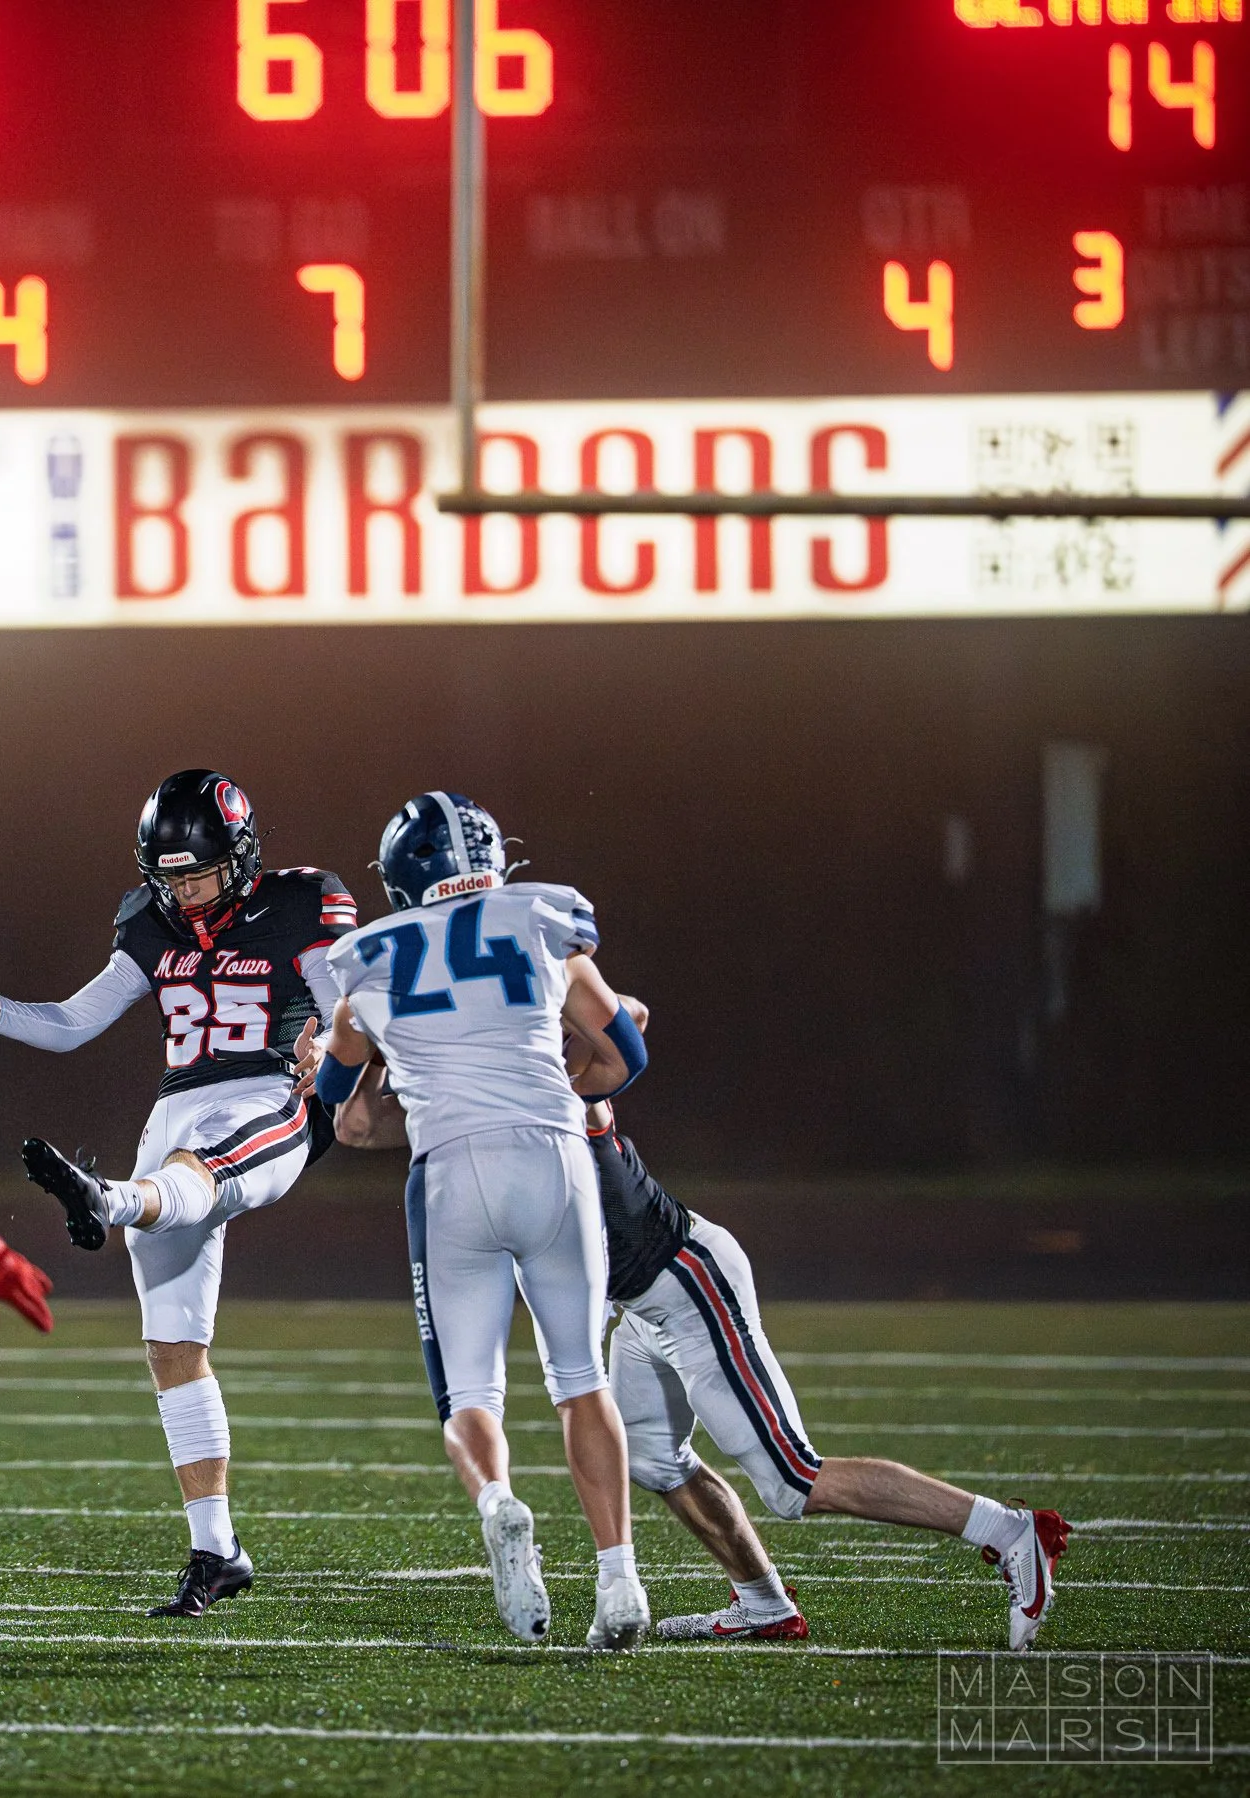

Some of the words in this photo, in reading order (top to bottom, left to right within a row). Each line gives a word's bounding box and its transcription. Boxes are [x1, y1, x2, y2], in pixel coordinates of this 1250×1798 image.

[1108, 40, 1216, 151] 14
[297, 264, 365, 381] 7
[883, 260, 954, 371] 4
[1073, 231, 1125, 330] 3
[161, 855, 190, 865] Riddell
[437, 874, 493, 897] Riddell
[153, 949, 203, 979] Mill
[211, 949, 273, 978] Town
[354, 899, 538, 1019] 24
[158, 980, 271, 1070] 35
